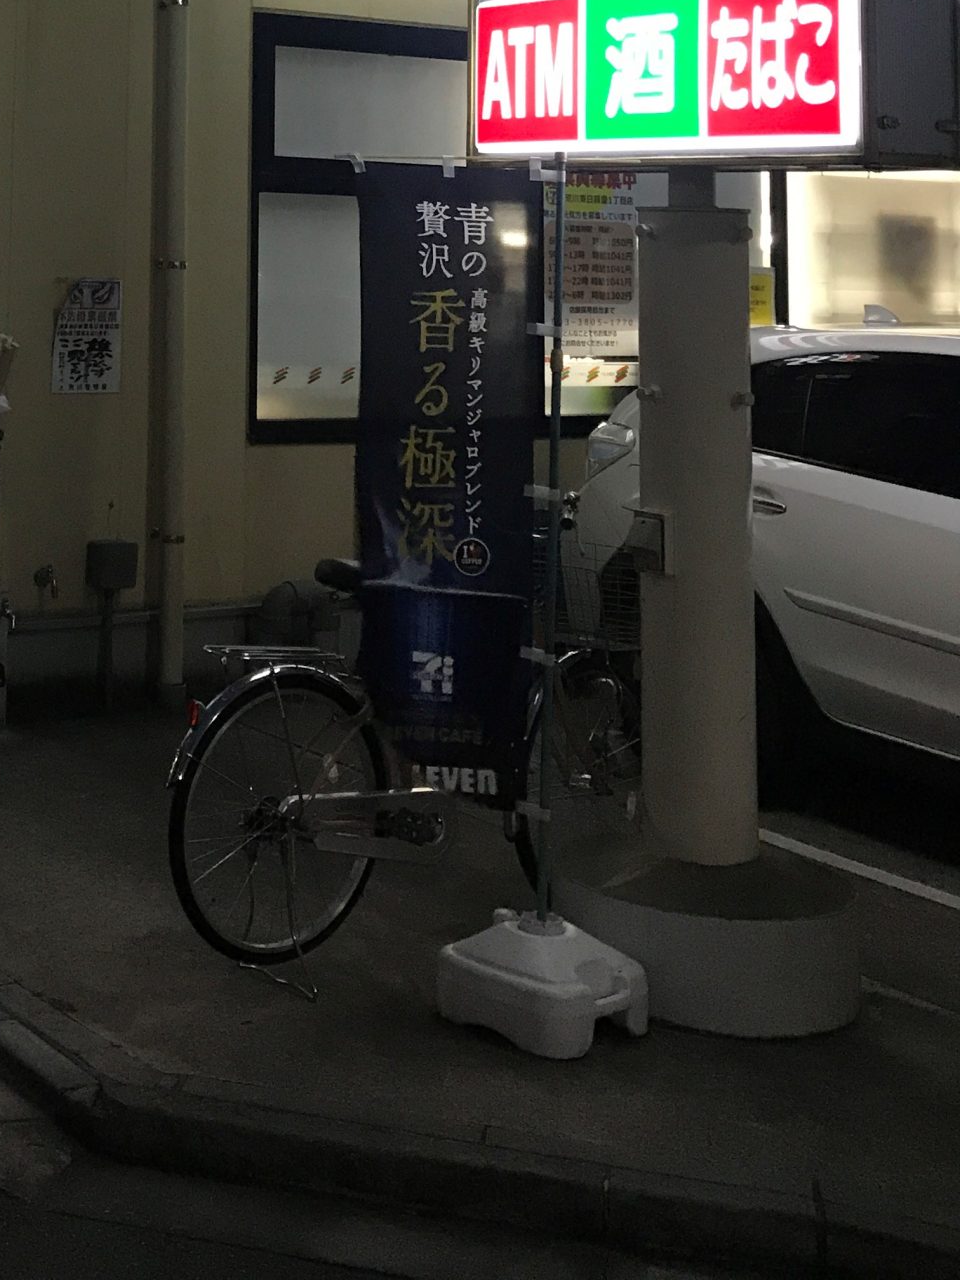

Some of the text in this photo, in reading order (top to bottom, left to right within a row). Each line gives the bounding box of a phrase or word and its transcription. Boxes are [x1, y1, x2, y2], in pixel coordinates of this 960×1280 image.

[482, 22, 573, 119] ATM
[605, 12, 679, 118] 酒
[415, 200, 456, 279] 贅沢
[454, 203, 495, 535] 青の 高級キリマンジャロブレンド
